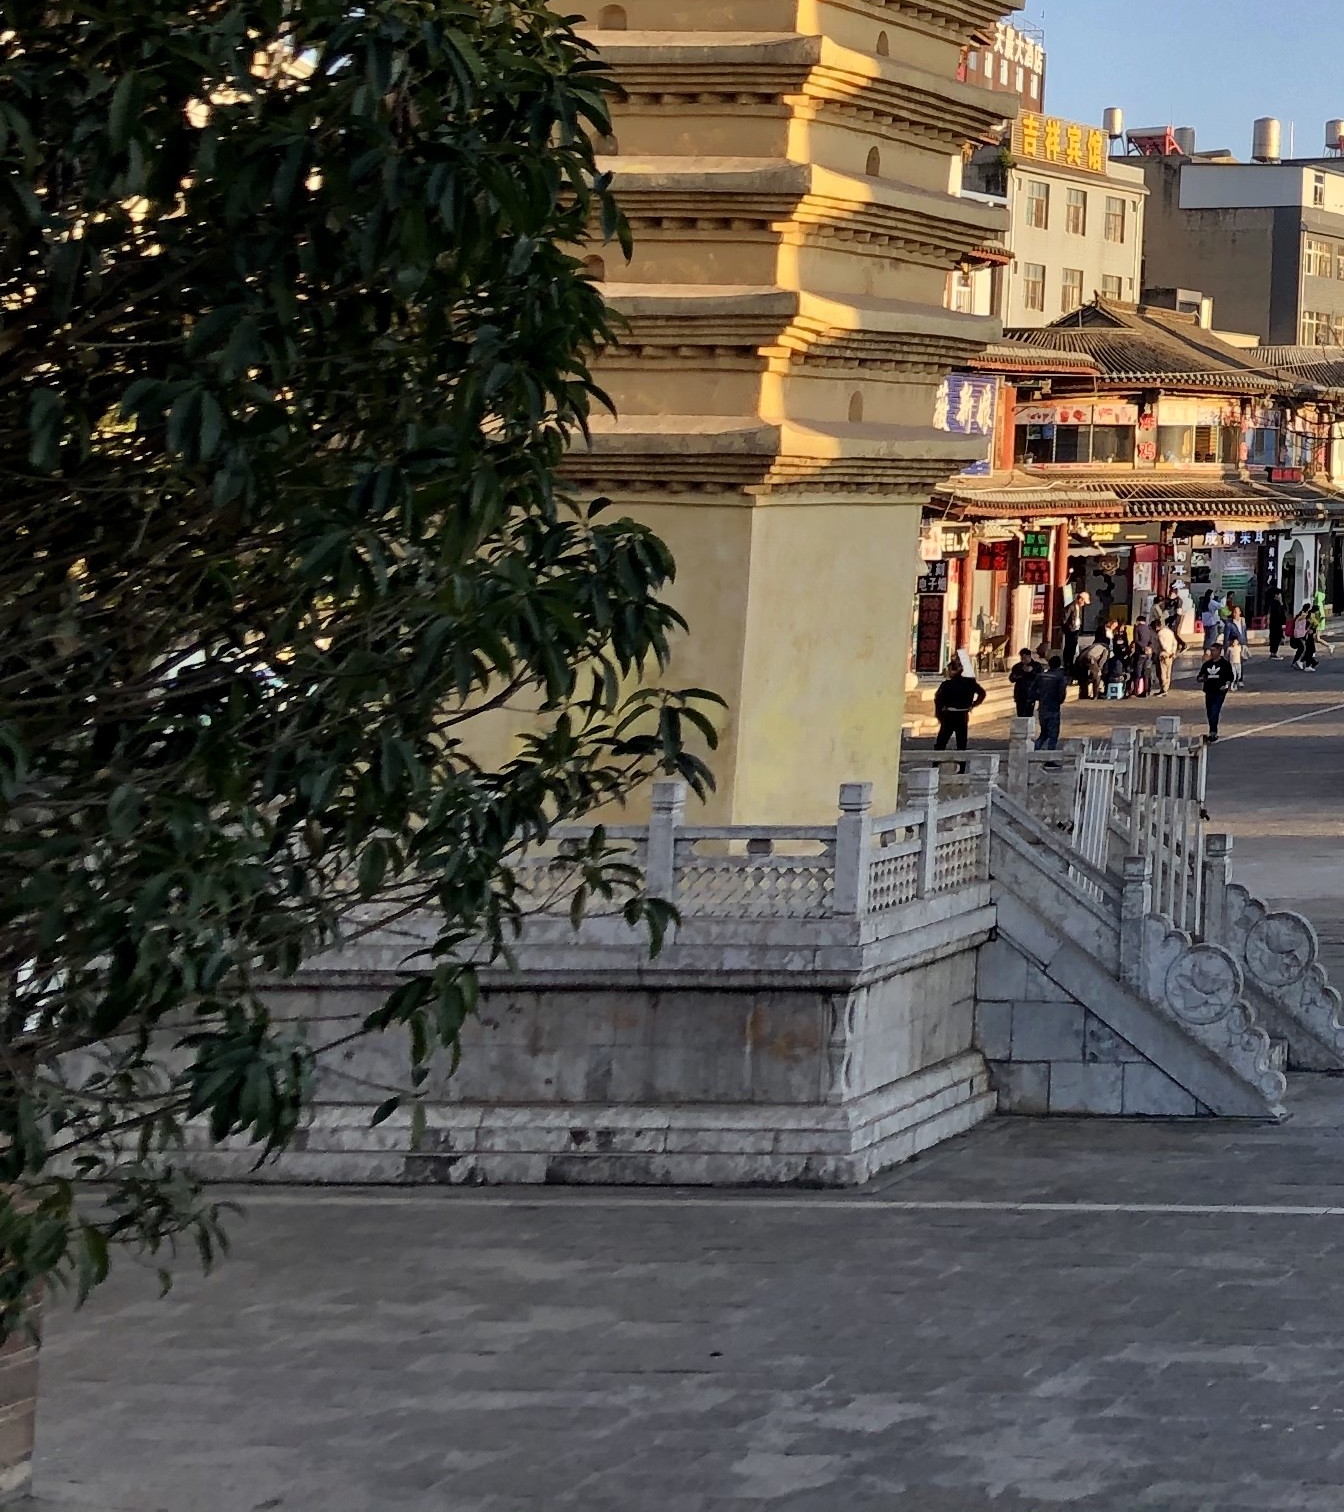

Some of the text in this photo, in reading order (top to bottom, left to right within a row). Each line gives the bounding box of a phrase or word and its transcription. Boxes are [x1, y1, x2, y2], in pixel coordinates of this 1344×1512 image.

[1022, 114, 1103, 171] 吉祥宾馆
[1204, 530, 1265, 546] 成都采耳
